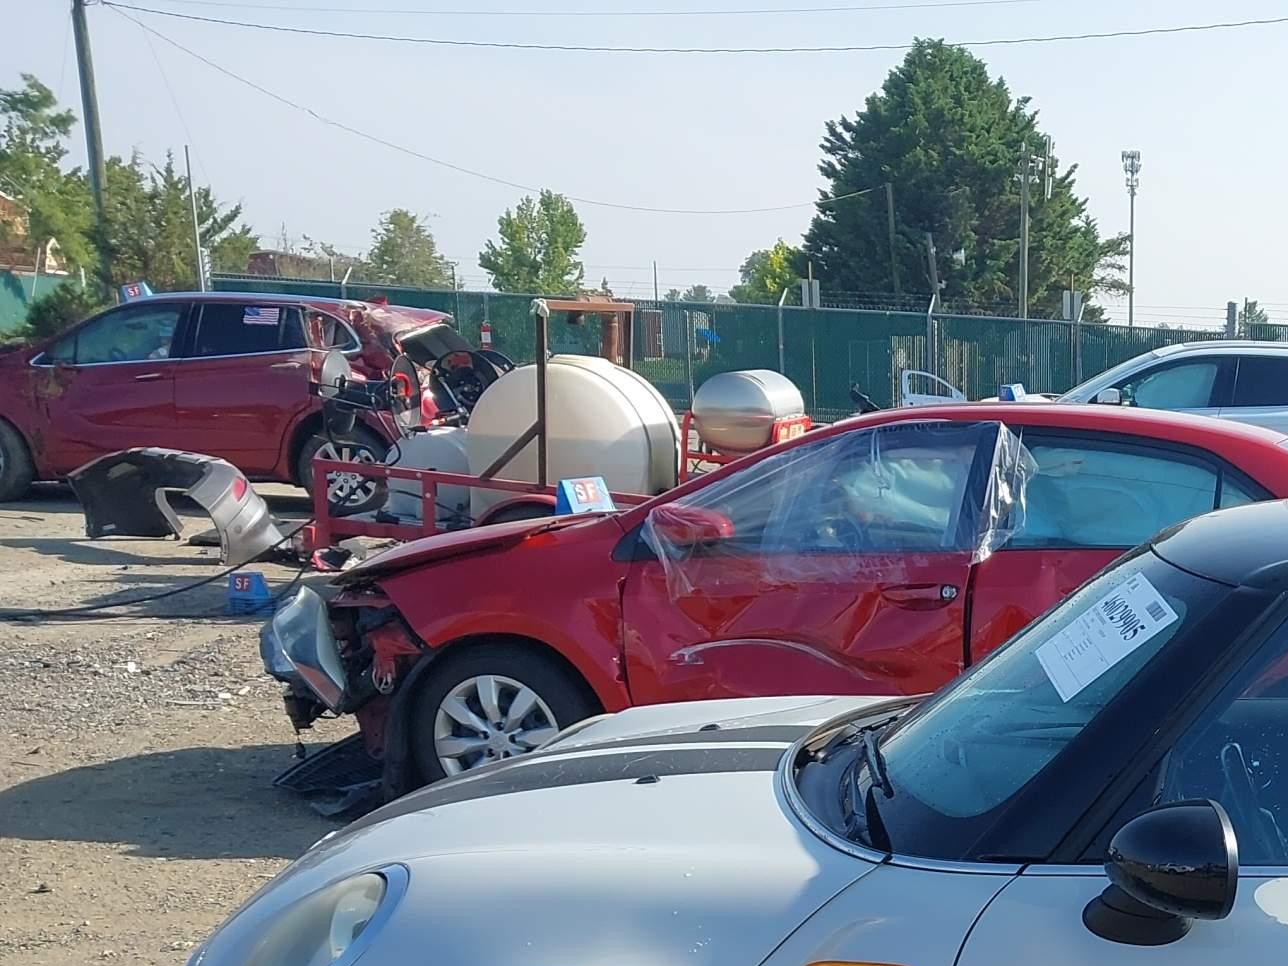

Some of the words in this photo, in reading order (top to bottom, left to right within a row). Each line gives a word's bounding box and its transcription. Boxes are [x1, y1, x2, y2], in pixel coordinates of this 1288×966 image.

[574, 482, 597, 501] SF
[234, 577, 250, 590] SF
[1101, 593, 1146, 641] 46029905
